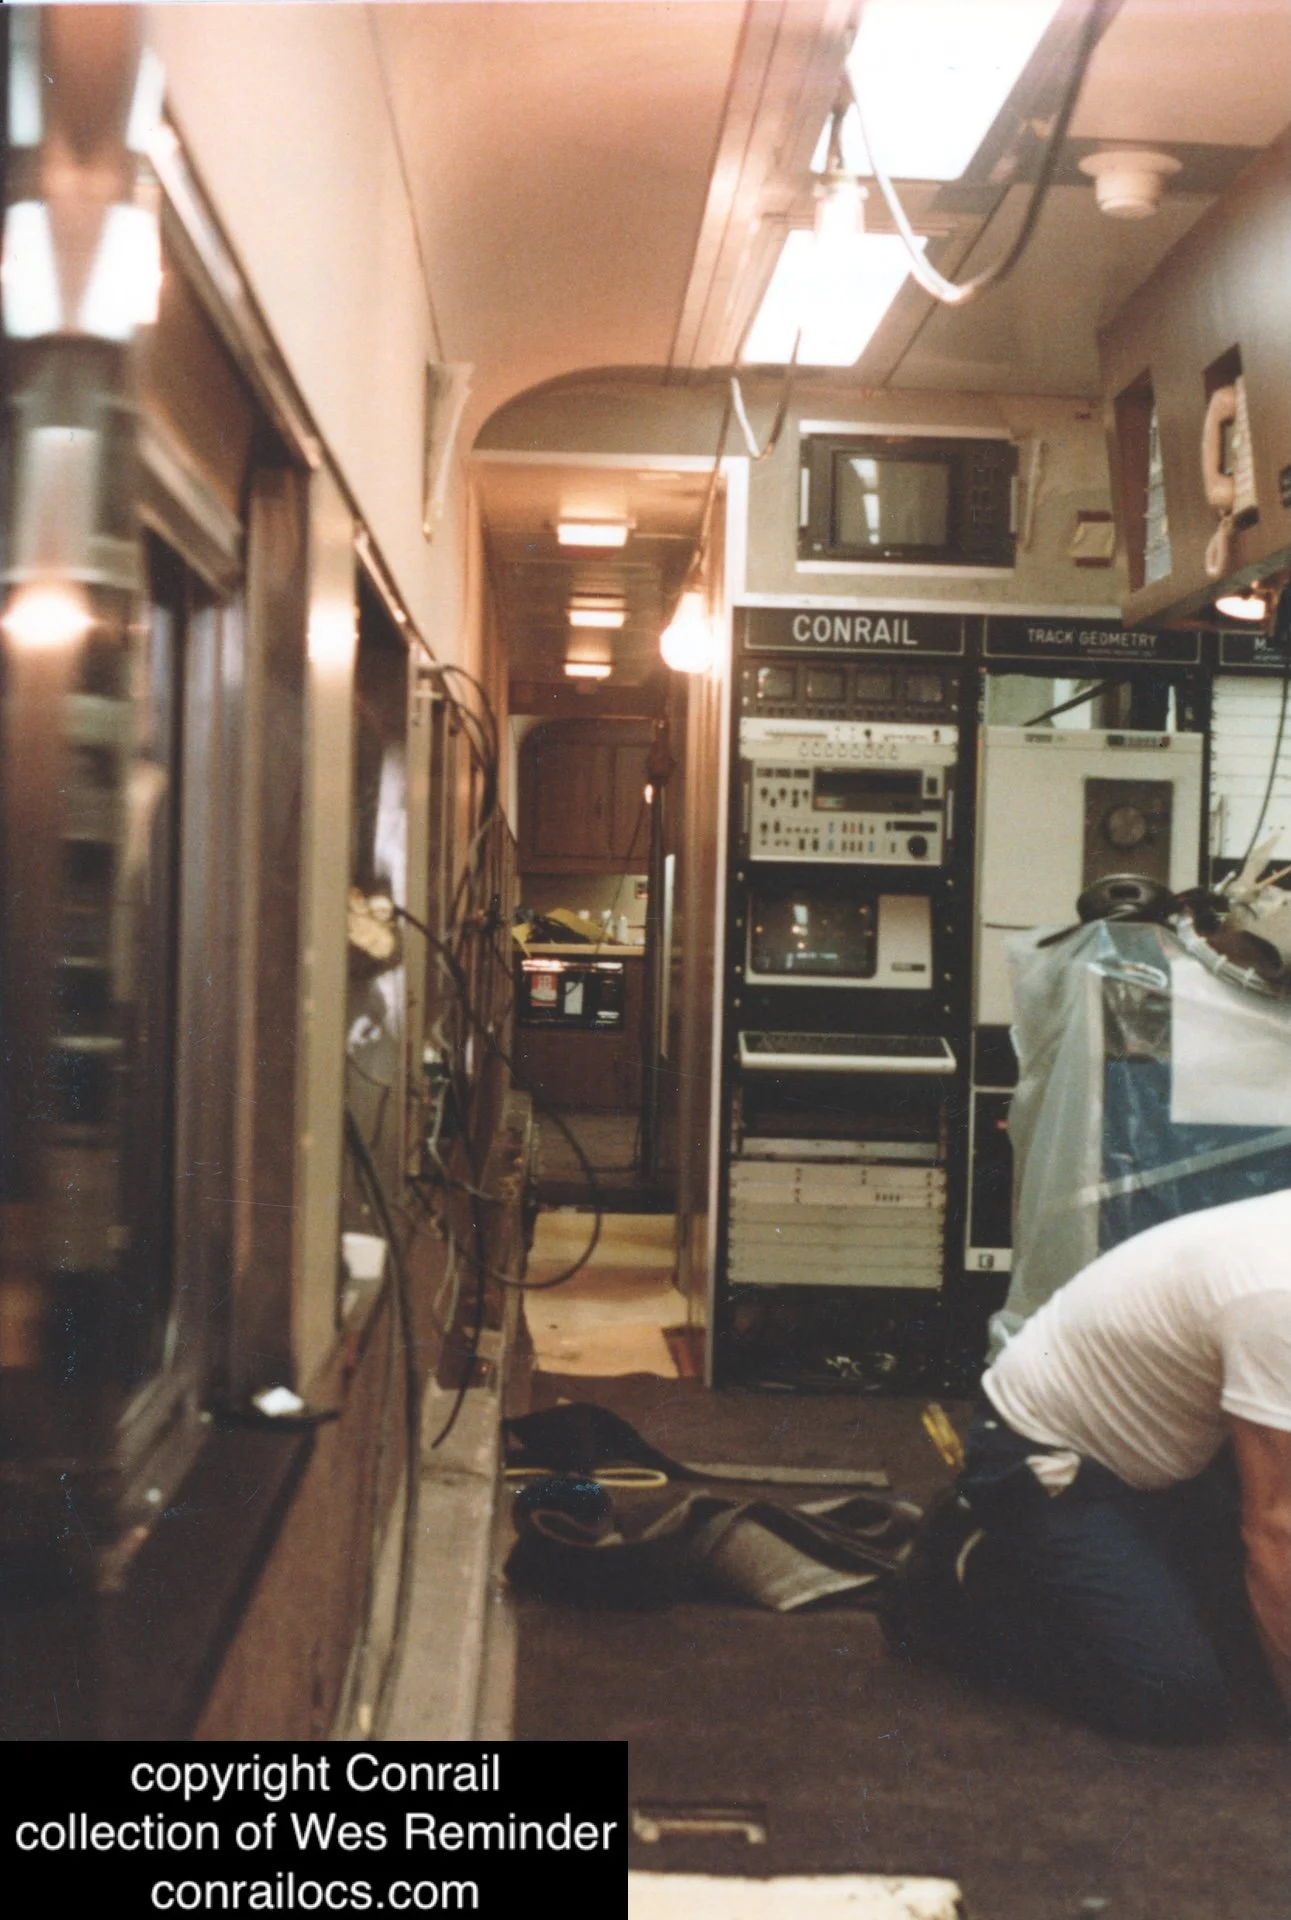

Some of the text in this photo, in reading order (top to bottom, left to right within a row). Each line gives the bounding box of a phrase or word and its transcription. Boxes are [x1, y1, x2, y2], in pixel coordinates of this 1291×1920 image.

[792, 614, 918, 645] CONRAIL
[1027, 627, 1158, 648] TRACK GEOMETRY
